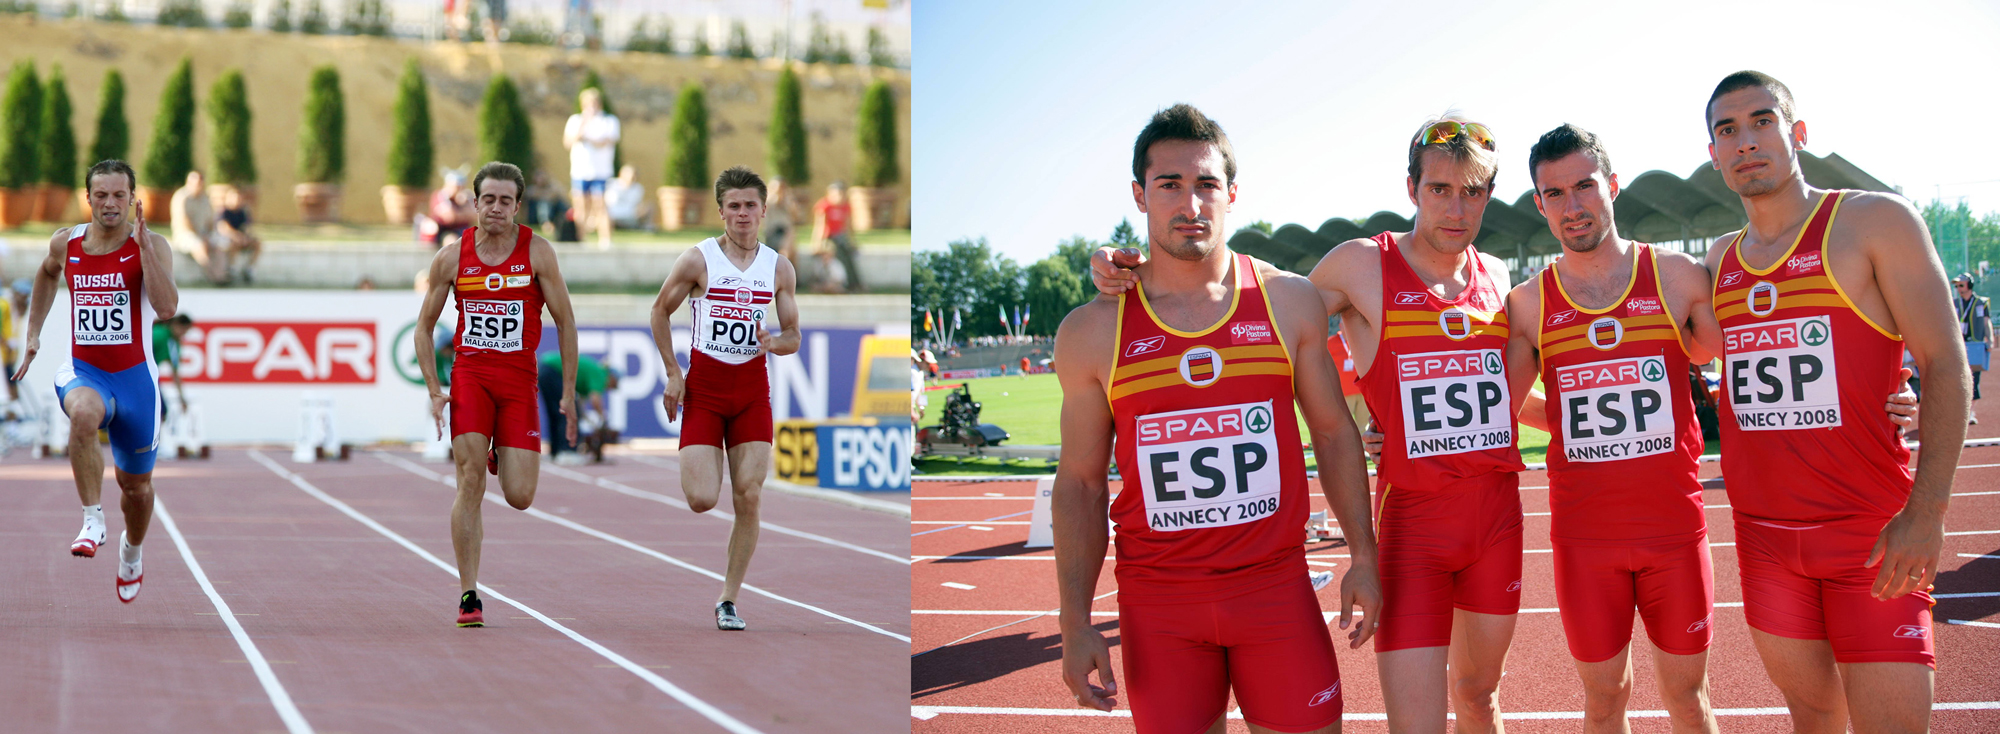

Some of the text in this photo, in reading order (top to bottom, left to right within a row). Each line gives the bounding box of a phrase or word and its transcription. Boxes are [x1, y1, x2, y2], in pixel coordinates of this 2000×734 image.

[510, 264, 525, 272] ESP
[73, 272, 126, 289] RUSSIA
[76, 295, 113, 304] SPAR
[466, 302, 506, 314] SPAR
[78, 308, 124, 332] RUS
[711, 306, 752, 320] SPAR
[110, 333, 129, 341] 2006
[468, 315, 518, 339] ESP
[711, 320, 757, 346] POL
[1245, 324, 1266, 332] Divina
[1726, 327, 1796, 350] SPAR
[464, 338, 520, 349] MALAGA 2006
[705, 343, 742, 354] MALAGA
[1401, 357, 1483, 378] SPAR
[1560, 365, 1639, 389] SPAR
[1732, 354, 1824, 405] ESP
[1411, 381, 1502, 431] ESP
[1569, 389, 1662, 439] ESP
[1737, 408, 1838, 427] NNECY 2008
[1140, 413, 1241, 441] SPAR
[1410, 430, 1510, 455] ANNECY 2008
[1568, 437, 1672, 460] ANNECY 2008
[1150, 442, 1268, 502] ESP
[1151, 497, 1277, 528] ANNECY 2008
